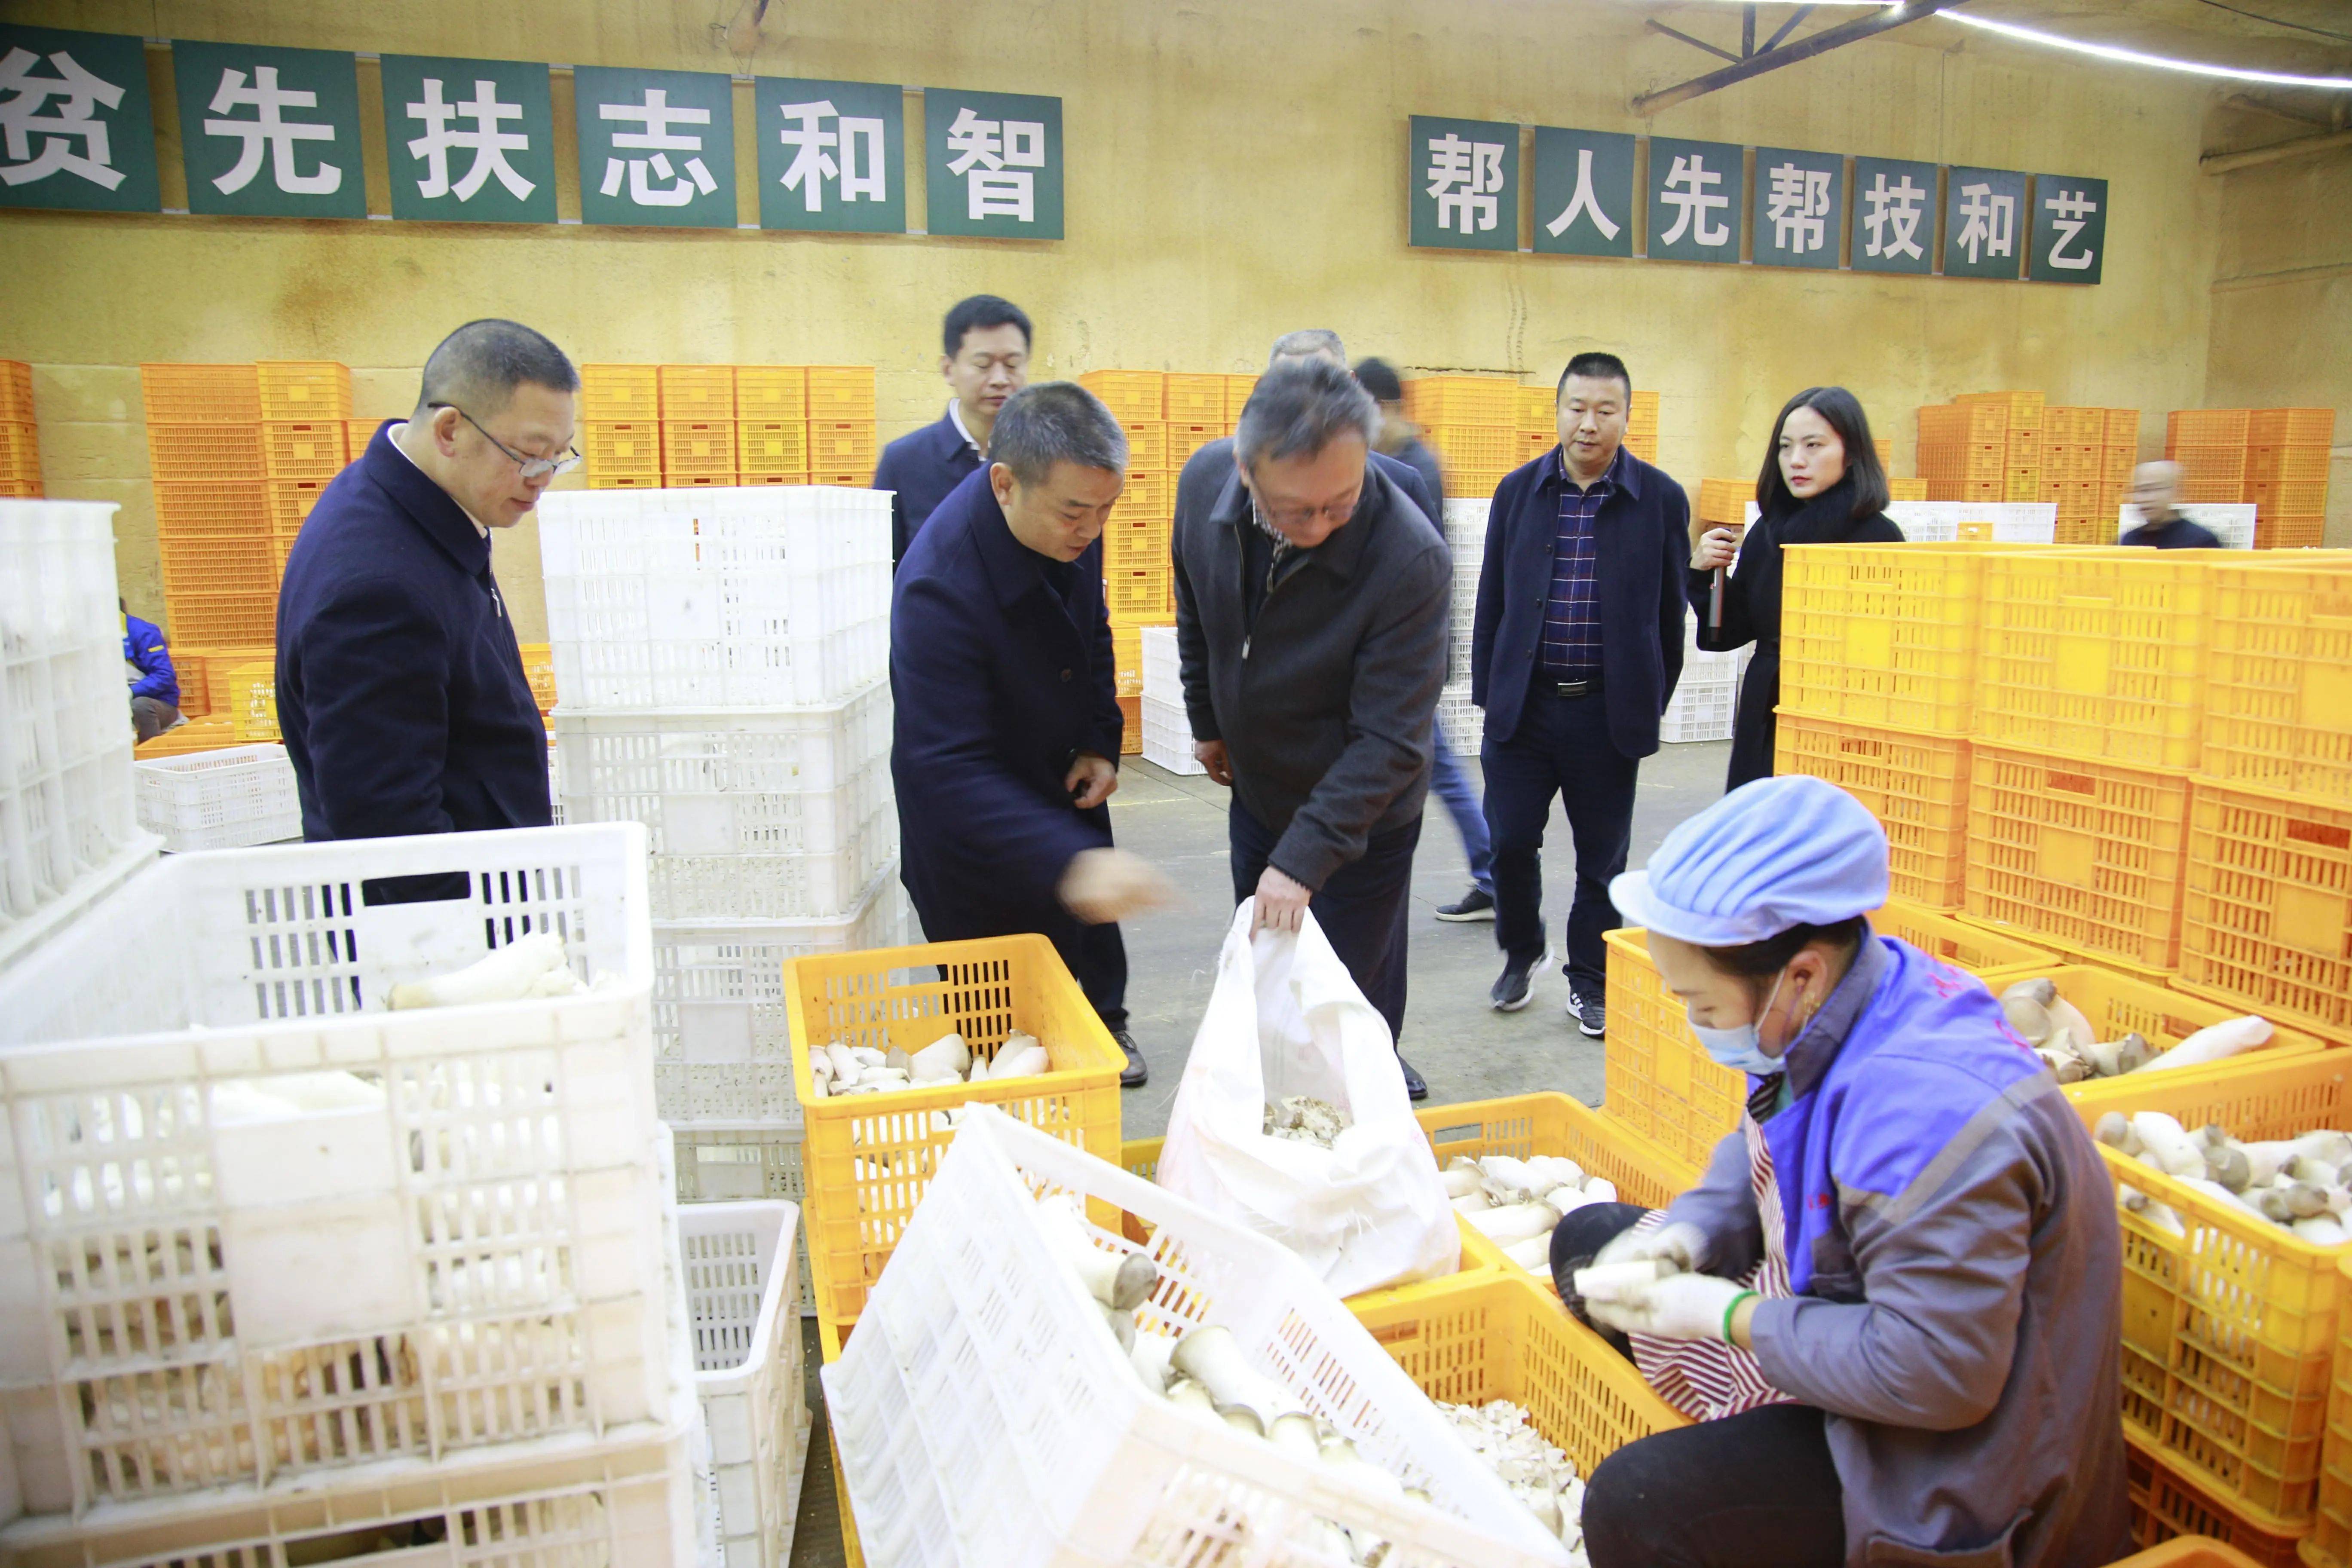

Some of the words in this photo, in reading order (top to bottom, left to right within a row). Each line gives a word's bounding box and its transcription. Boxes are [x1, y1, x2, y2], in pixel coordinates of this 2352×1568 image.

[0, 46, 1046, 223] 贫先扶志和智
[1425, 133, 2097, 269] 帮人先帮技和艺
